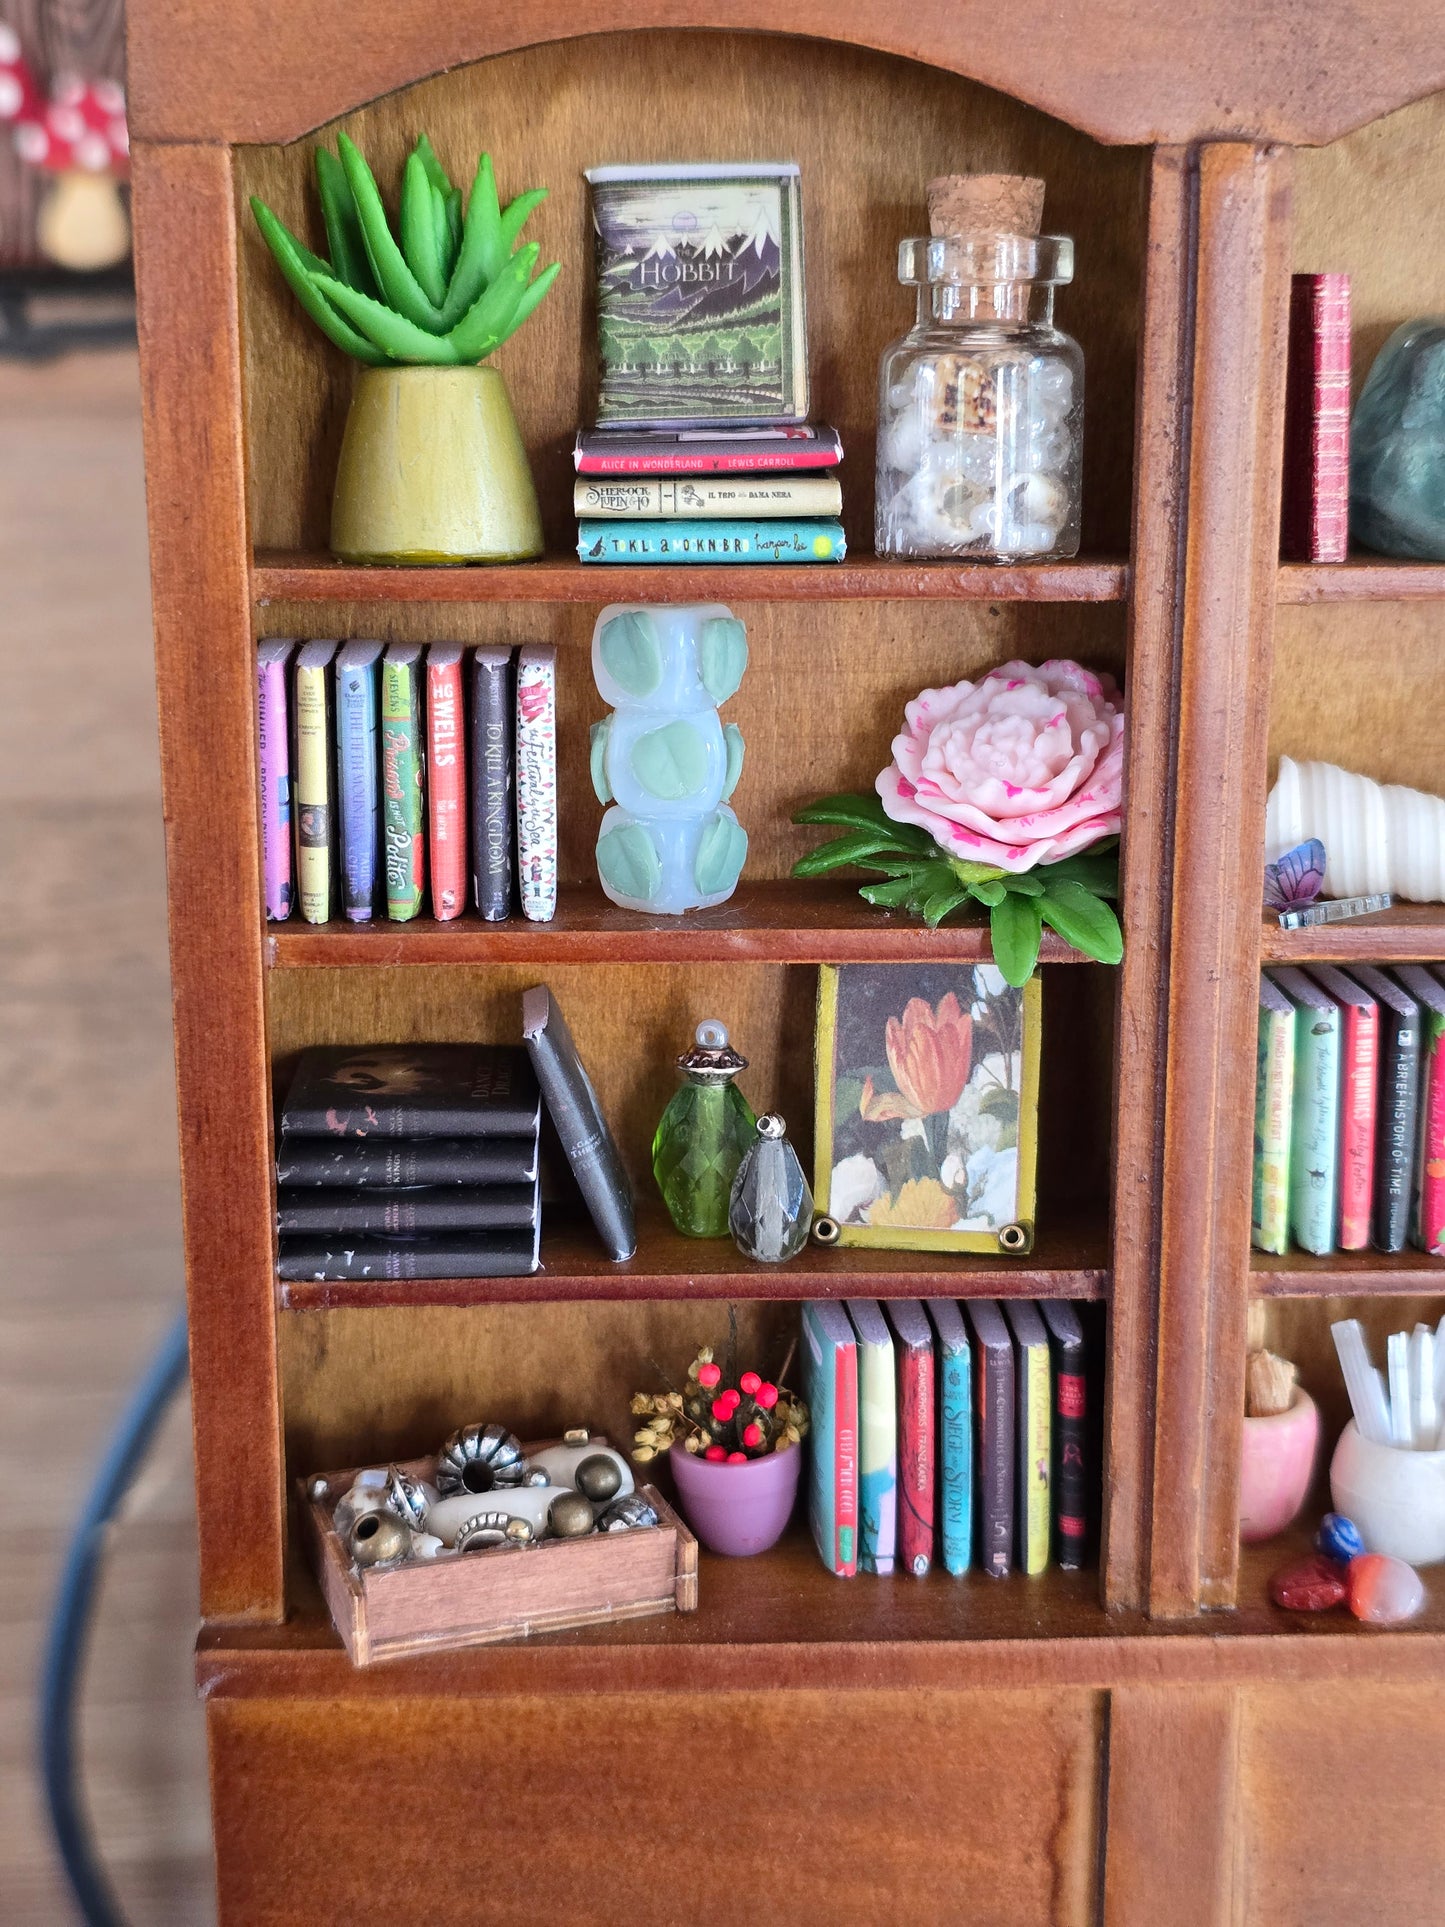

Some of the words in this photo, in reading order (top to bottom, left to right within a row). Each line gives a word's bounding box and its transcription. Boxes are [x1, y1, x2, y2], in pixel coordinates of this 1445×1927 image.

[641, 262, 740, 284] HOBBIT
[601, 460, 626, 469] ALICE
[629, 460, 640, 469] IN
[642, 459, 704, 469] WONDERLAND
[728, 459, 755, 467] LEWIS
[757, 457, 796, 466] CARROLL
[586, 486, 651, 506] SHERLOCK
[389, 674, 400, 713] STEVENS
[350, 710, 363, 733] THE
[433, 699, 456, 767] WELLS
[486, 720, 504, 740] TO
[484, 744, 504, 774] KILL
[521, 737, 545, 797] Festival
[487, 777, 502, 788] A
[485, 791, 504, 875] KINGDOM
[524, 820, 546, 849] Sea
[386, 825, 412, 890] Polite
[1356, 1017, 1374, 1035] THE
[1355, 1038, 1374, 1063] DEAD
[1398, 1053, 1412, 1061] A
[1350, 1066, 1374, 1120] ROMANTICS
[1395, 1062, 1413, 1096] BRIEF
[1391, 1099, 1410, 1147] HISTORY
[393, 1153, 401, 1184] KINGS
[1390, 1149, 1408, 1164] OF
[1388, 1167, 1406, 1195] TIME
[916, 1355, 928, 1427] METAMORPHOSIS
[943, 1406, 968, 1456] SIEGE
[996, 1396, 1007, 1454] CHRONICLES
[916, 1434, 927, 1461] FRANZ
[916, 1463, 927, 1492] KAFKA
[943, 1466, 968, 1524] STORM
